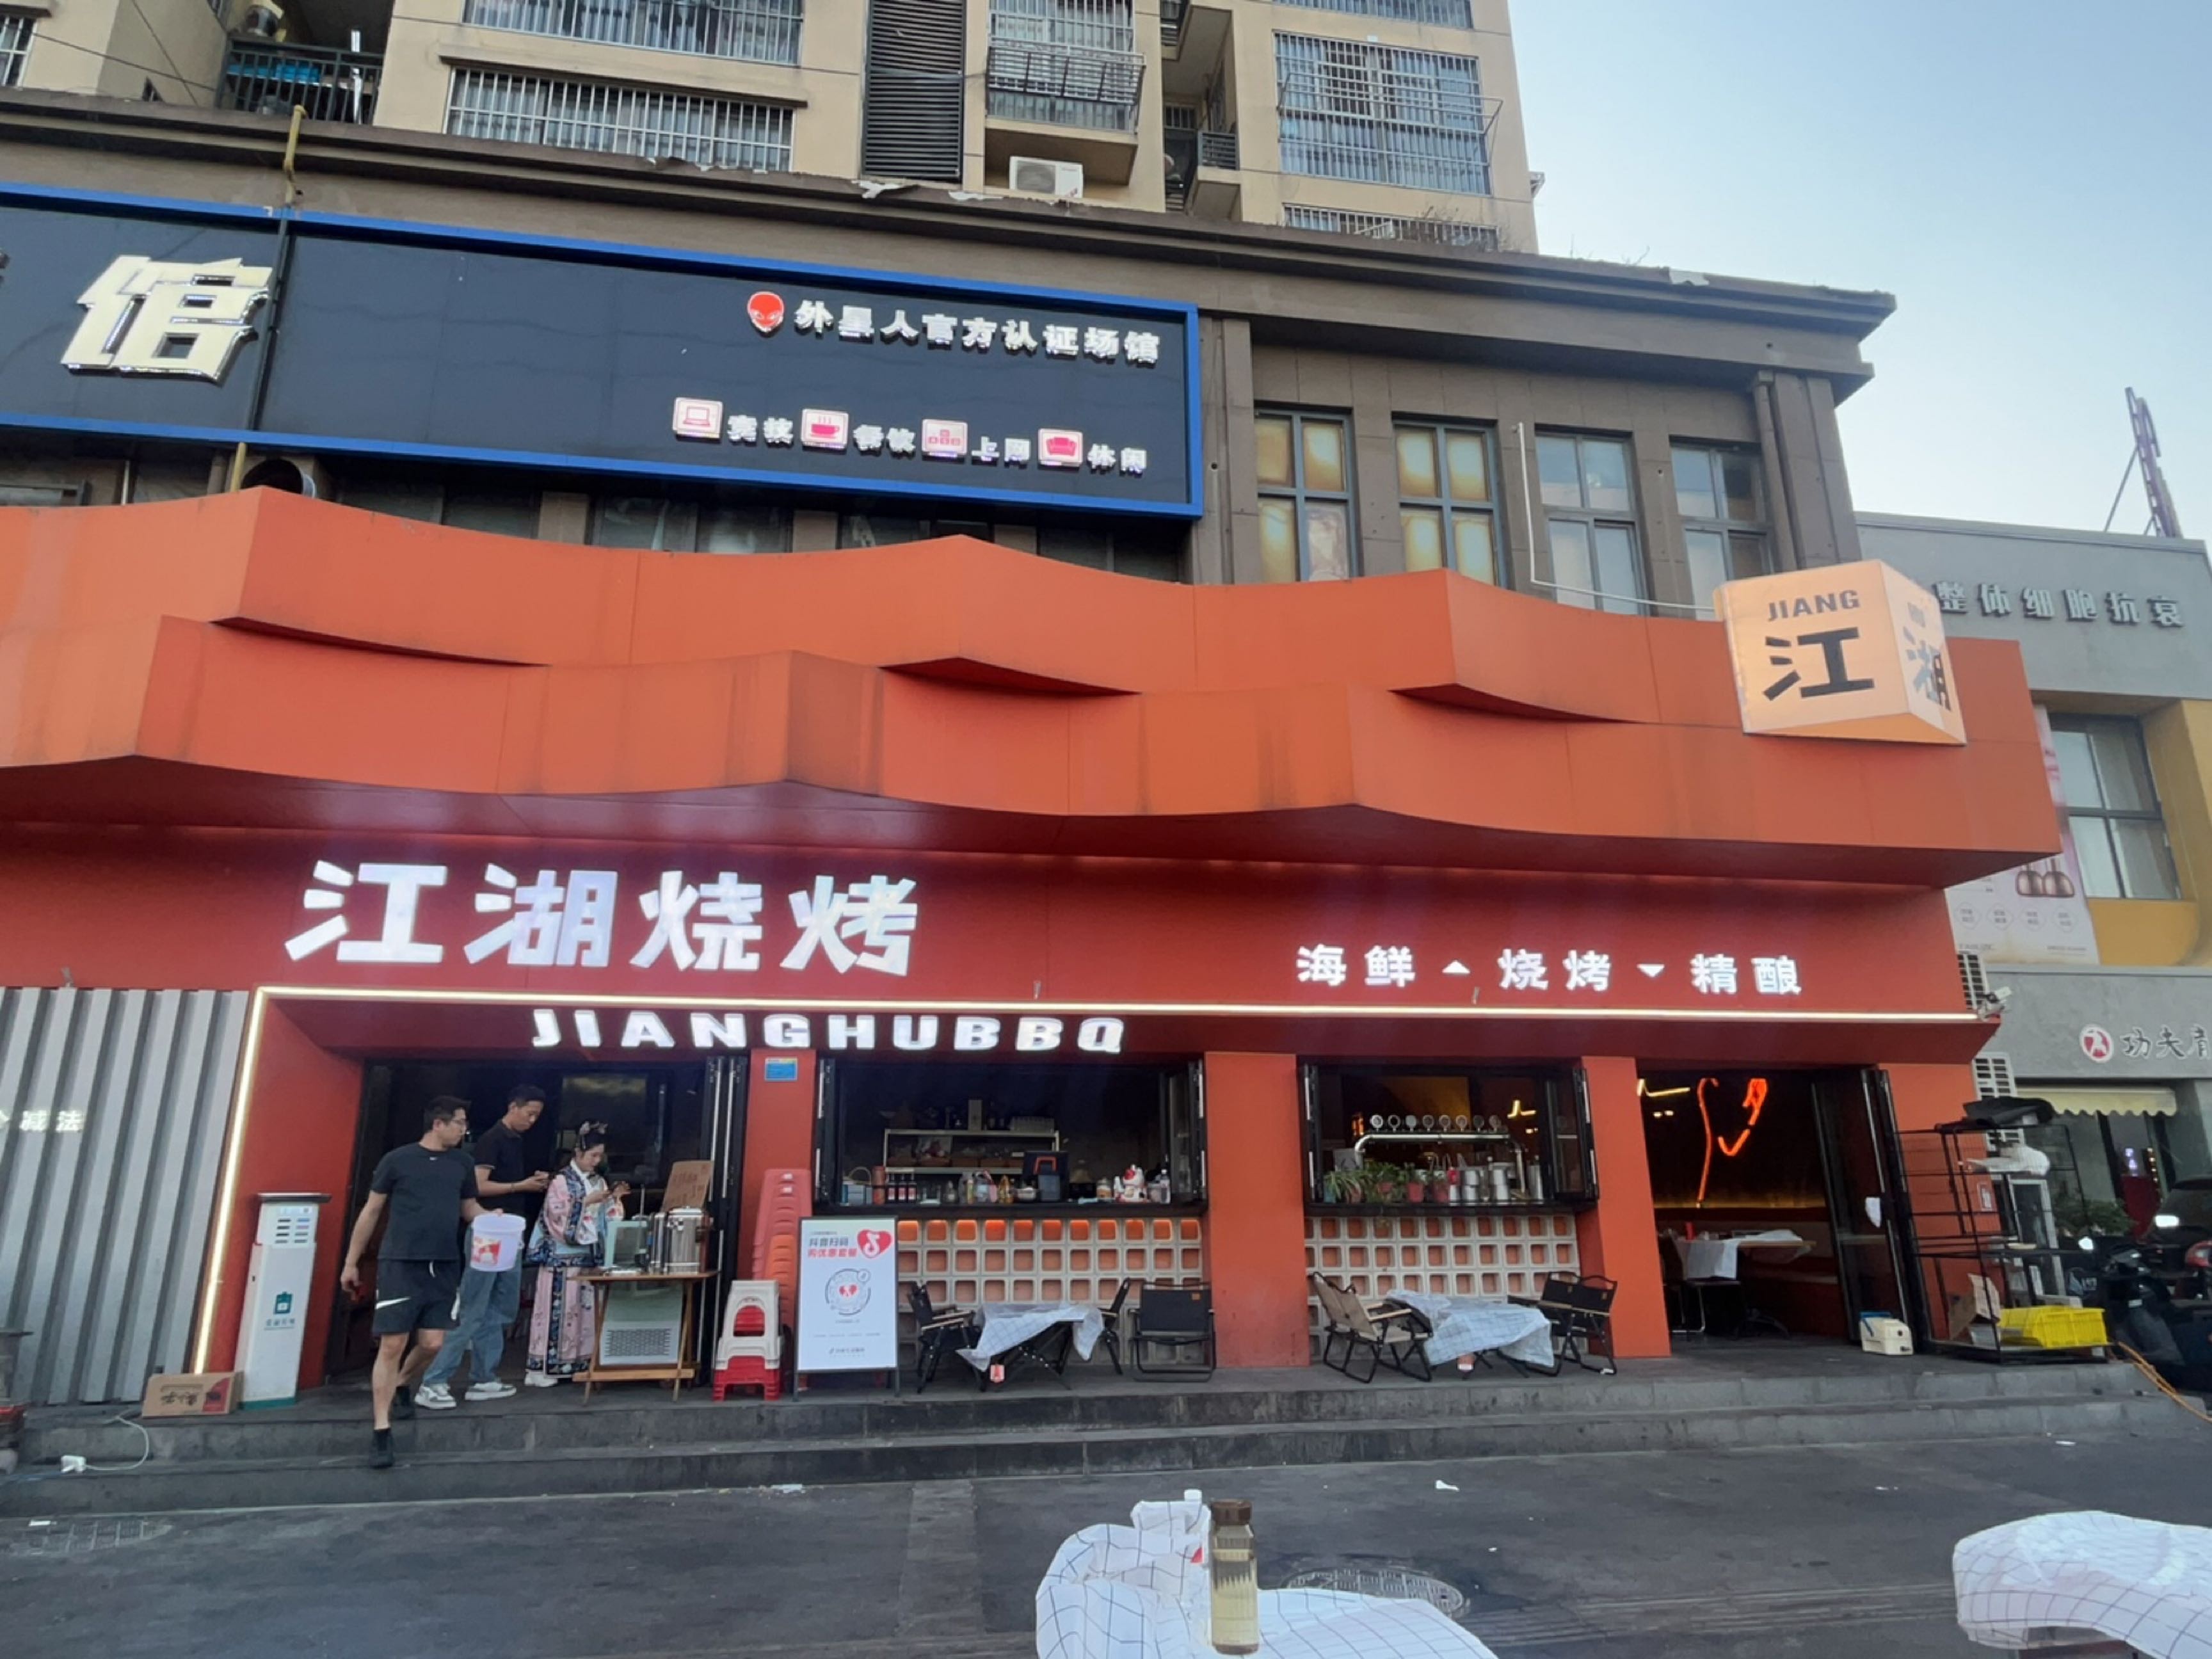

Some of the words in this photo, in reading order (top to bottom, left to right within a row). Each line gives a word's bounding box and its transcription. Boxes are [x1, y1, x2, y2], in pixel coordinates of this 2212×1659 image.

[794, 299, 1160, 364] 外星人官方认证场馆
[853, 424, 917, 453] 餐饮
[971, 436, 1031, 463] 上网
[1087, 443, 1148, 474] 休闲
[1768, 589, 1860, 622] JIANG
[1933, 580, 2184, 627] 整体细胞抗衰
[1763, 626, 1875, 701] 江
[285, 860, 918, 975] 江湖烧烤
[1295, 945, 1416, 988] 海鲜
[1497, 949, 1612, 991] 烧烤
[1690, 954, 1802, 995] 精酿
[532, 1008, 1125, 1054] JIANGHUBBQ
